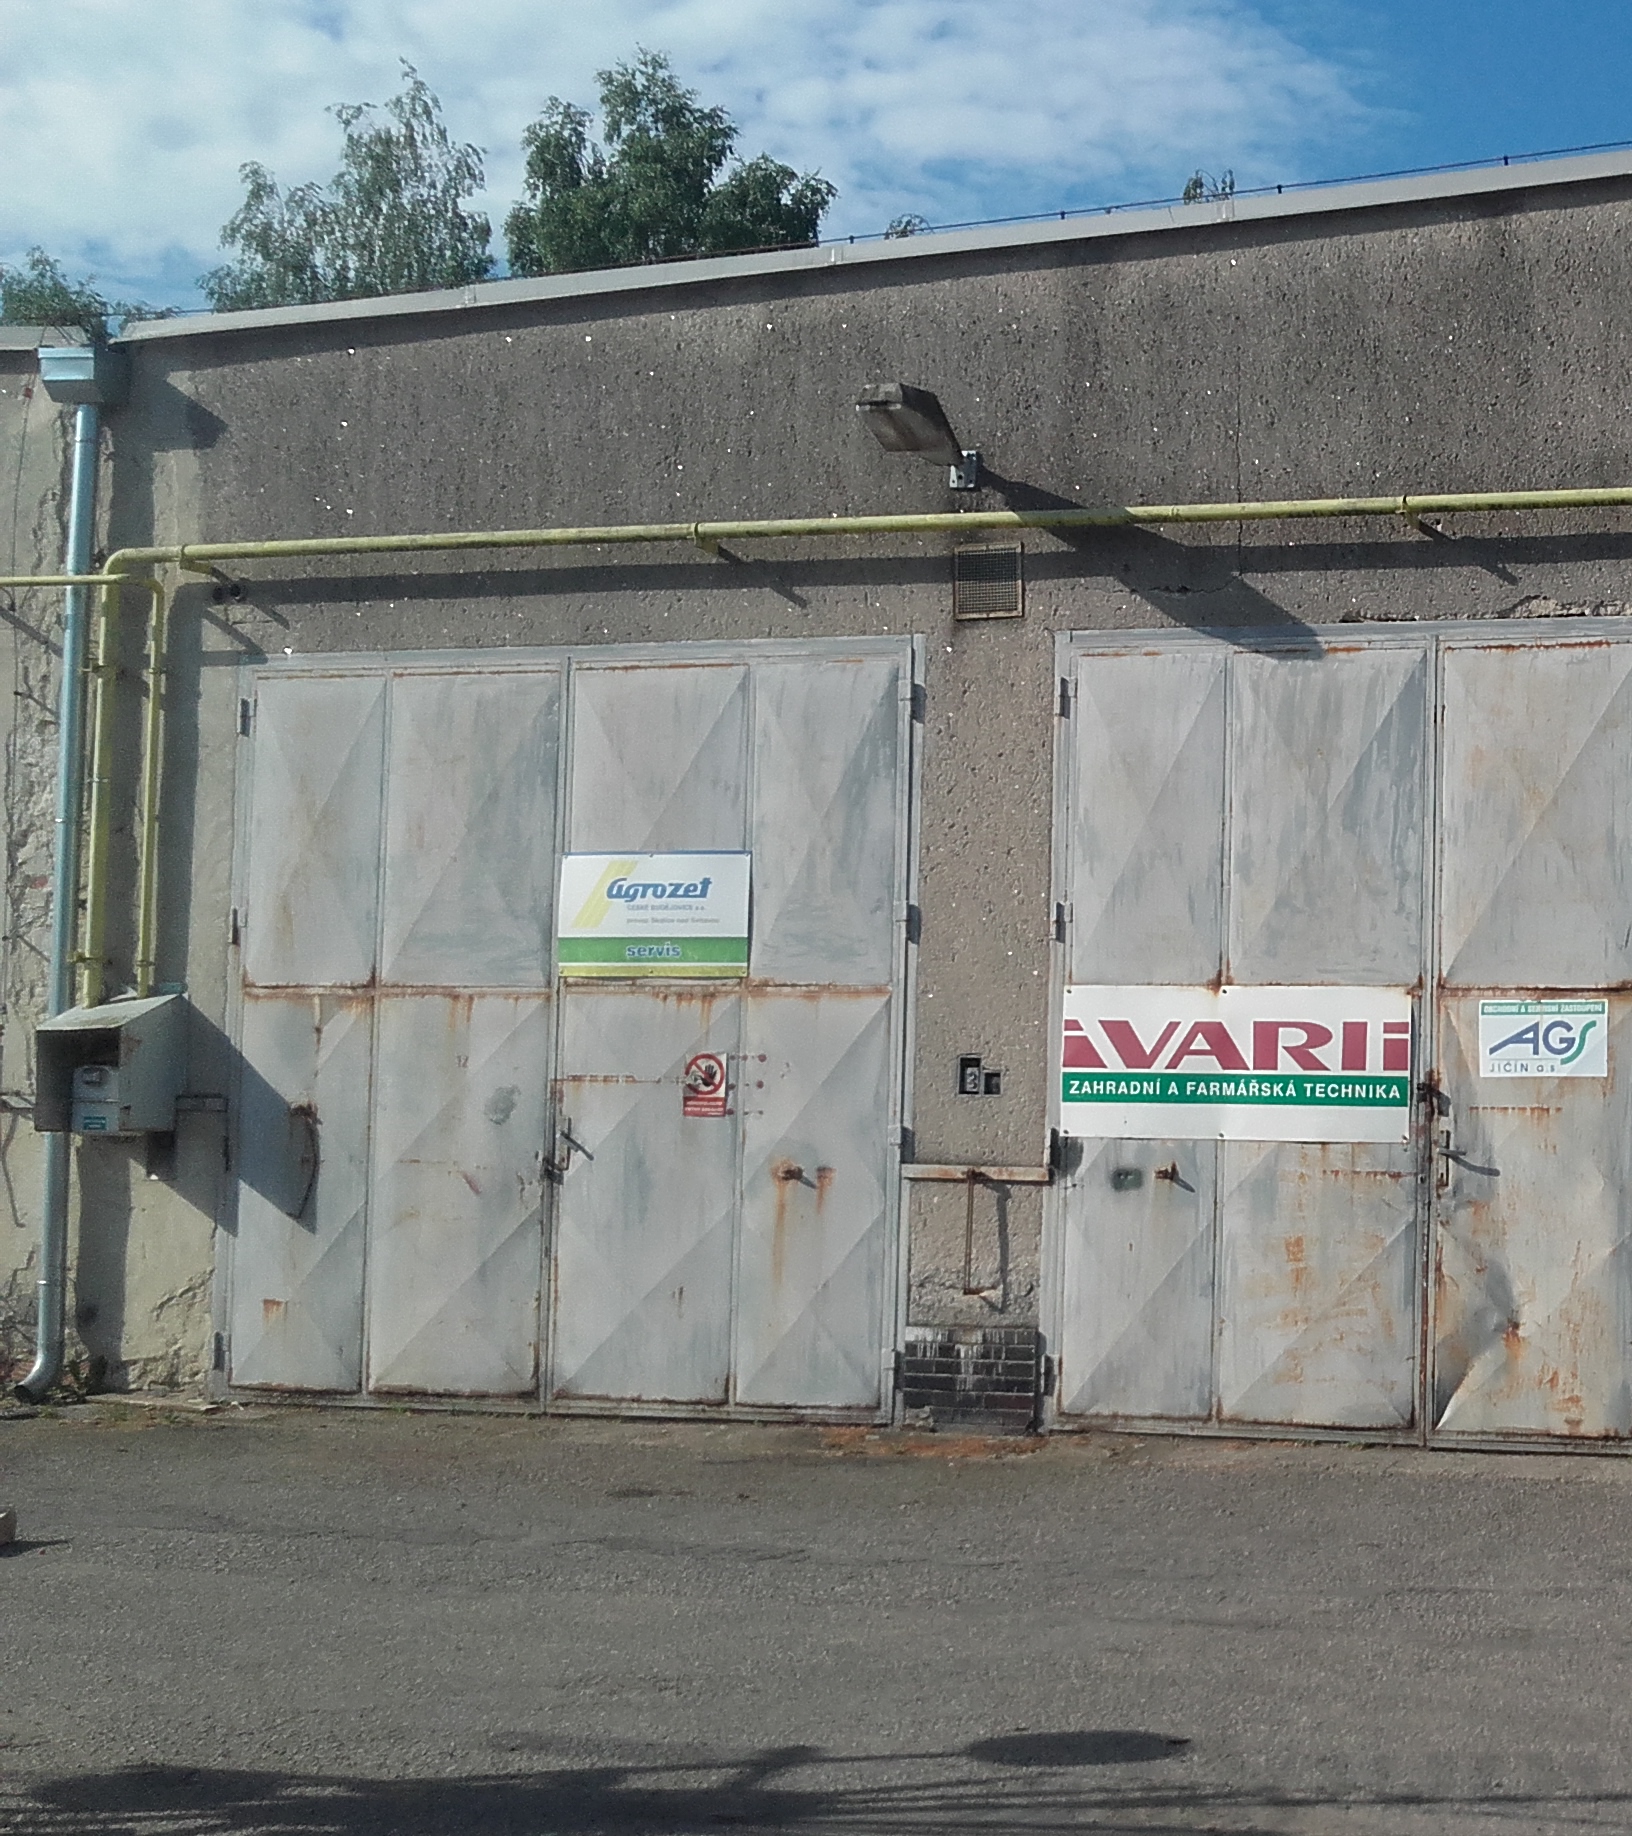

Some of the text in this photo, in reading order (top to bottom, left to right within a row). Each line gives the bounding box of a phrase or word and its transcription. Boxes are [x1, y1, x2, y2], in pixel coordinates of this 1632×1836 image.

[626, 942, 681, 957] servis
[1489, 1020, 1597, 1065] AGS
[1490, 1061, 1529, 1073] JIČÍN
[1069, 1077, 1401, 1099] ZAHRADNÍ A FARMÁŘSKÁ TECHNIKA
